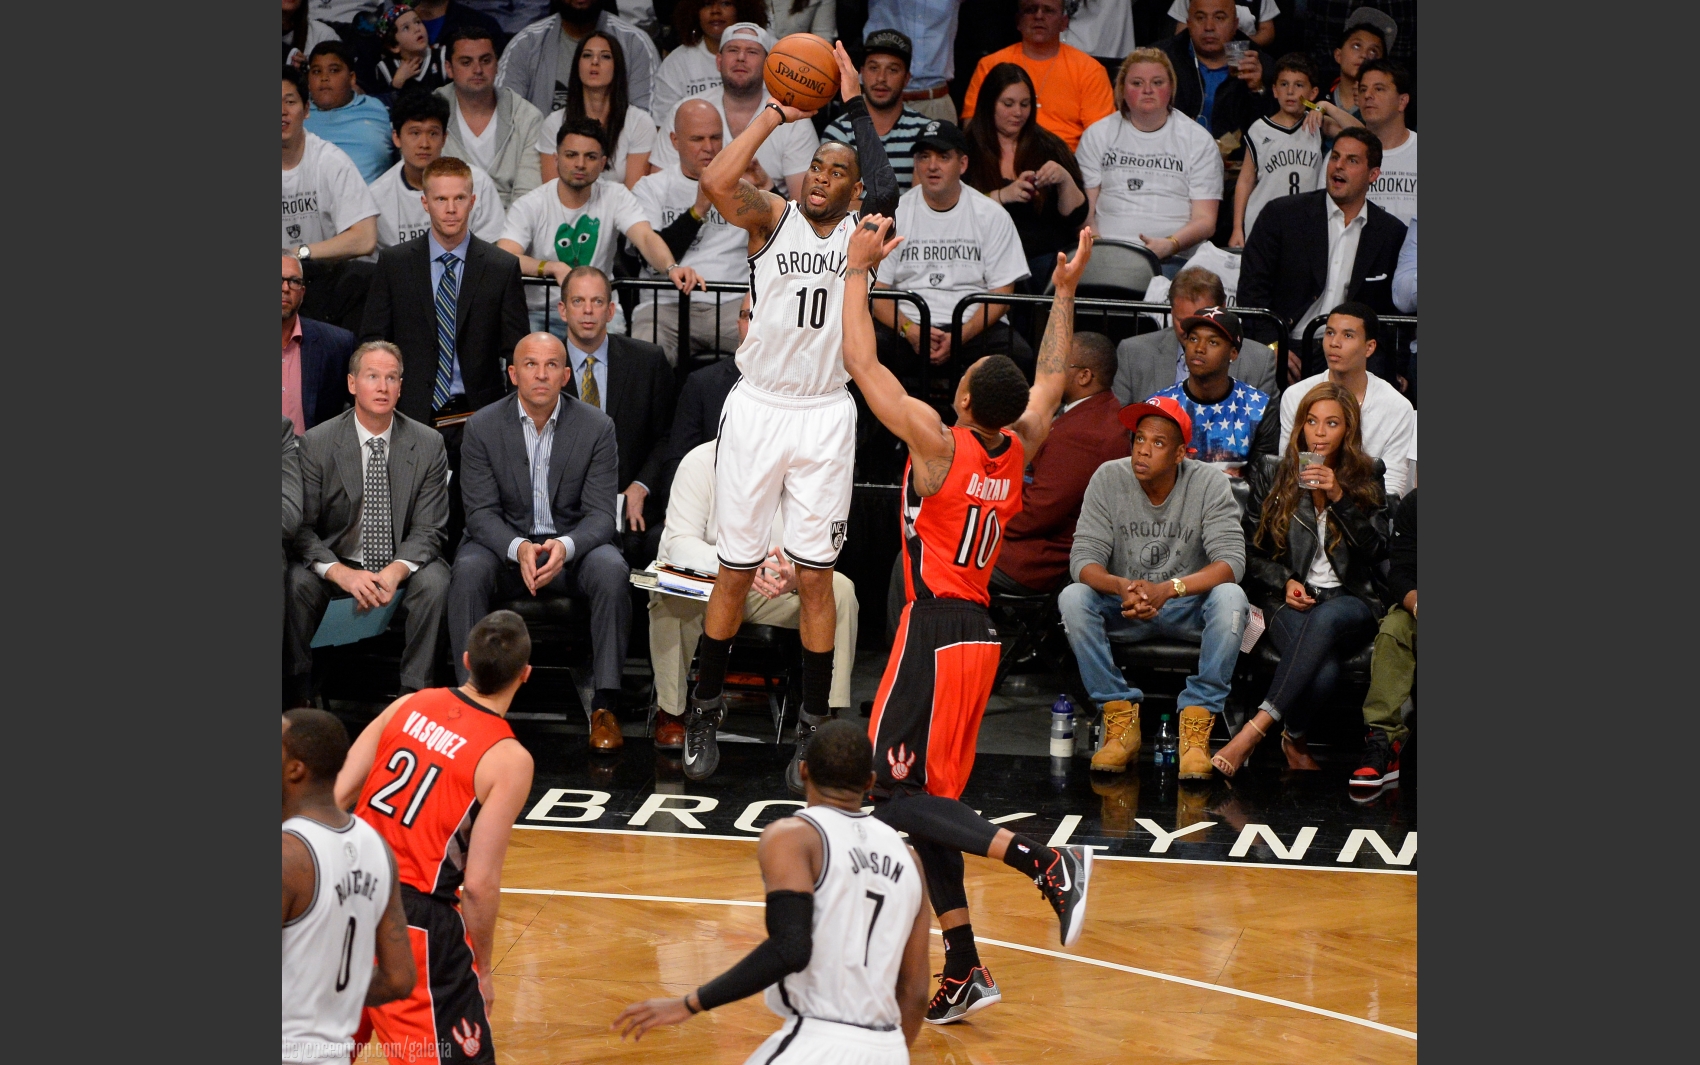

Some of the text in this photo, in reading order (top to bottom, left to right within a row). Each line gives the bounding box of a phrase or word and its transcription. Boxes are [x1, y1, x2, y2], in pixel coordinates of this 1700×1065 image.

[775, 62, 826, 94] SPALDING
[1119, 156, 1183, 172] BROOKLYN
[1289, 172, 1300, 195] 8
[1368, 178, 1417, 193] ROOKLY
[924, 244, 981, 261] BROOKLYN
[796, 287, 828, 329] 10
[953, 504, 1001, 570] 10
[402, 711, 467, 760] VASQUEZ
[367, 747, 443, 830] 21
[866, 890, 885, 967] 7
[336, 916, 356, 993] 0
